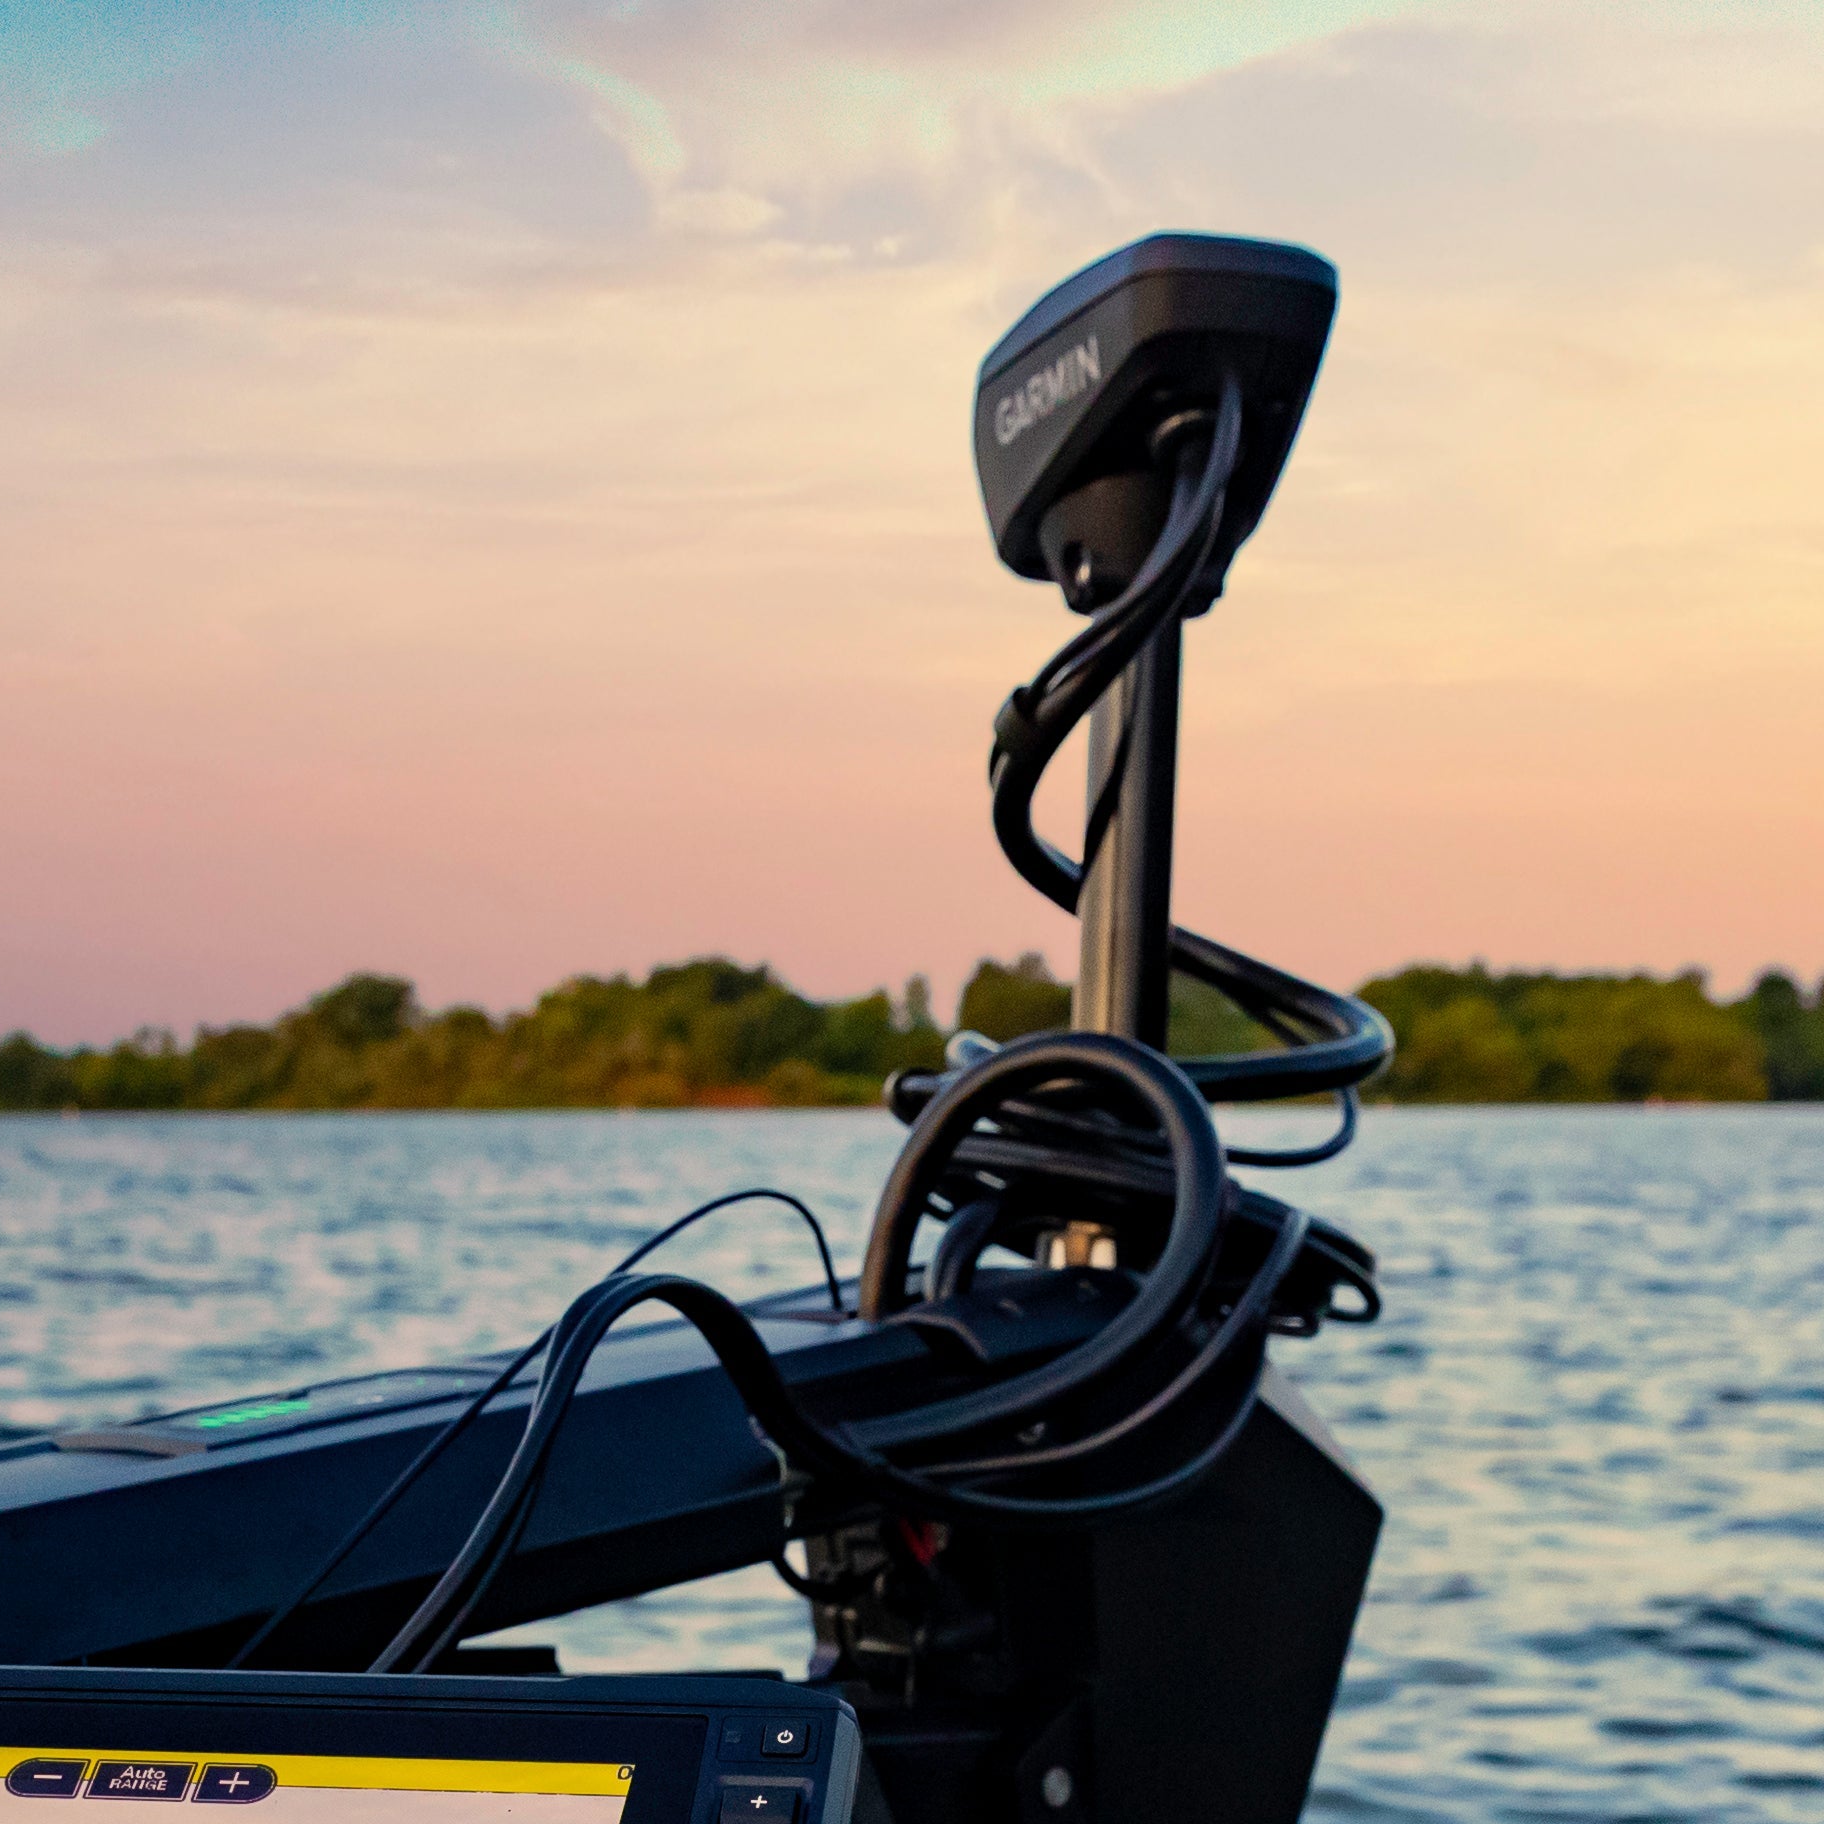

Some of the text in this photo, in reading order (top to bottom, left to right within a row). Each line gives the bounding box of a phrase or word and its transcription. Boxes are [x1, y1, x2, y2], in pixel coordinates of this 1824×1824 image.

[994, 334, 1101, 445] GARMIN
[120, 1766, 166, 1780] Auto
[617, 1765, 633, 1780] 0
